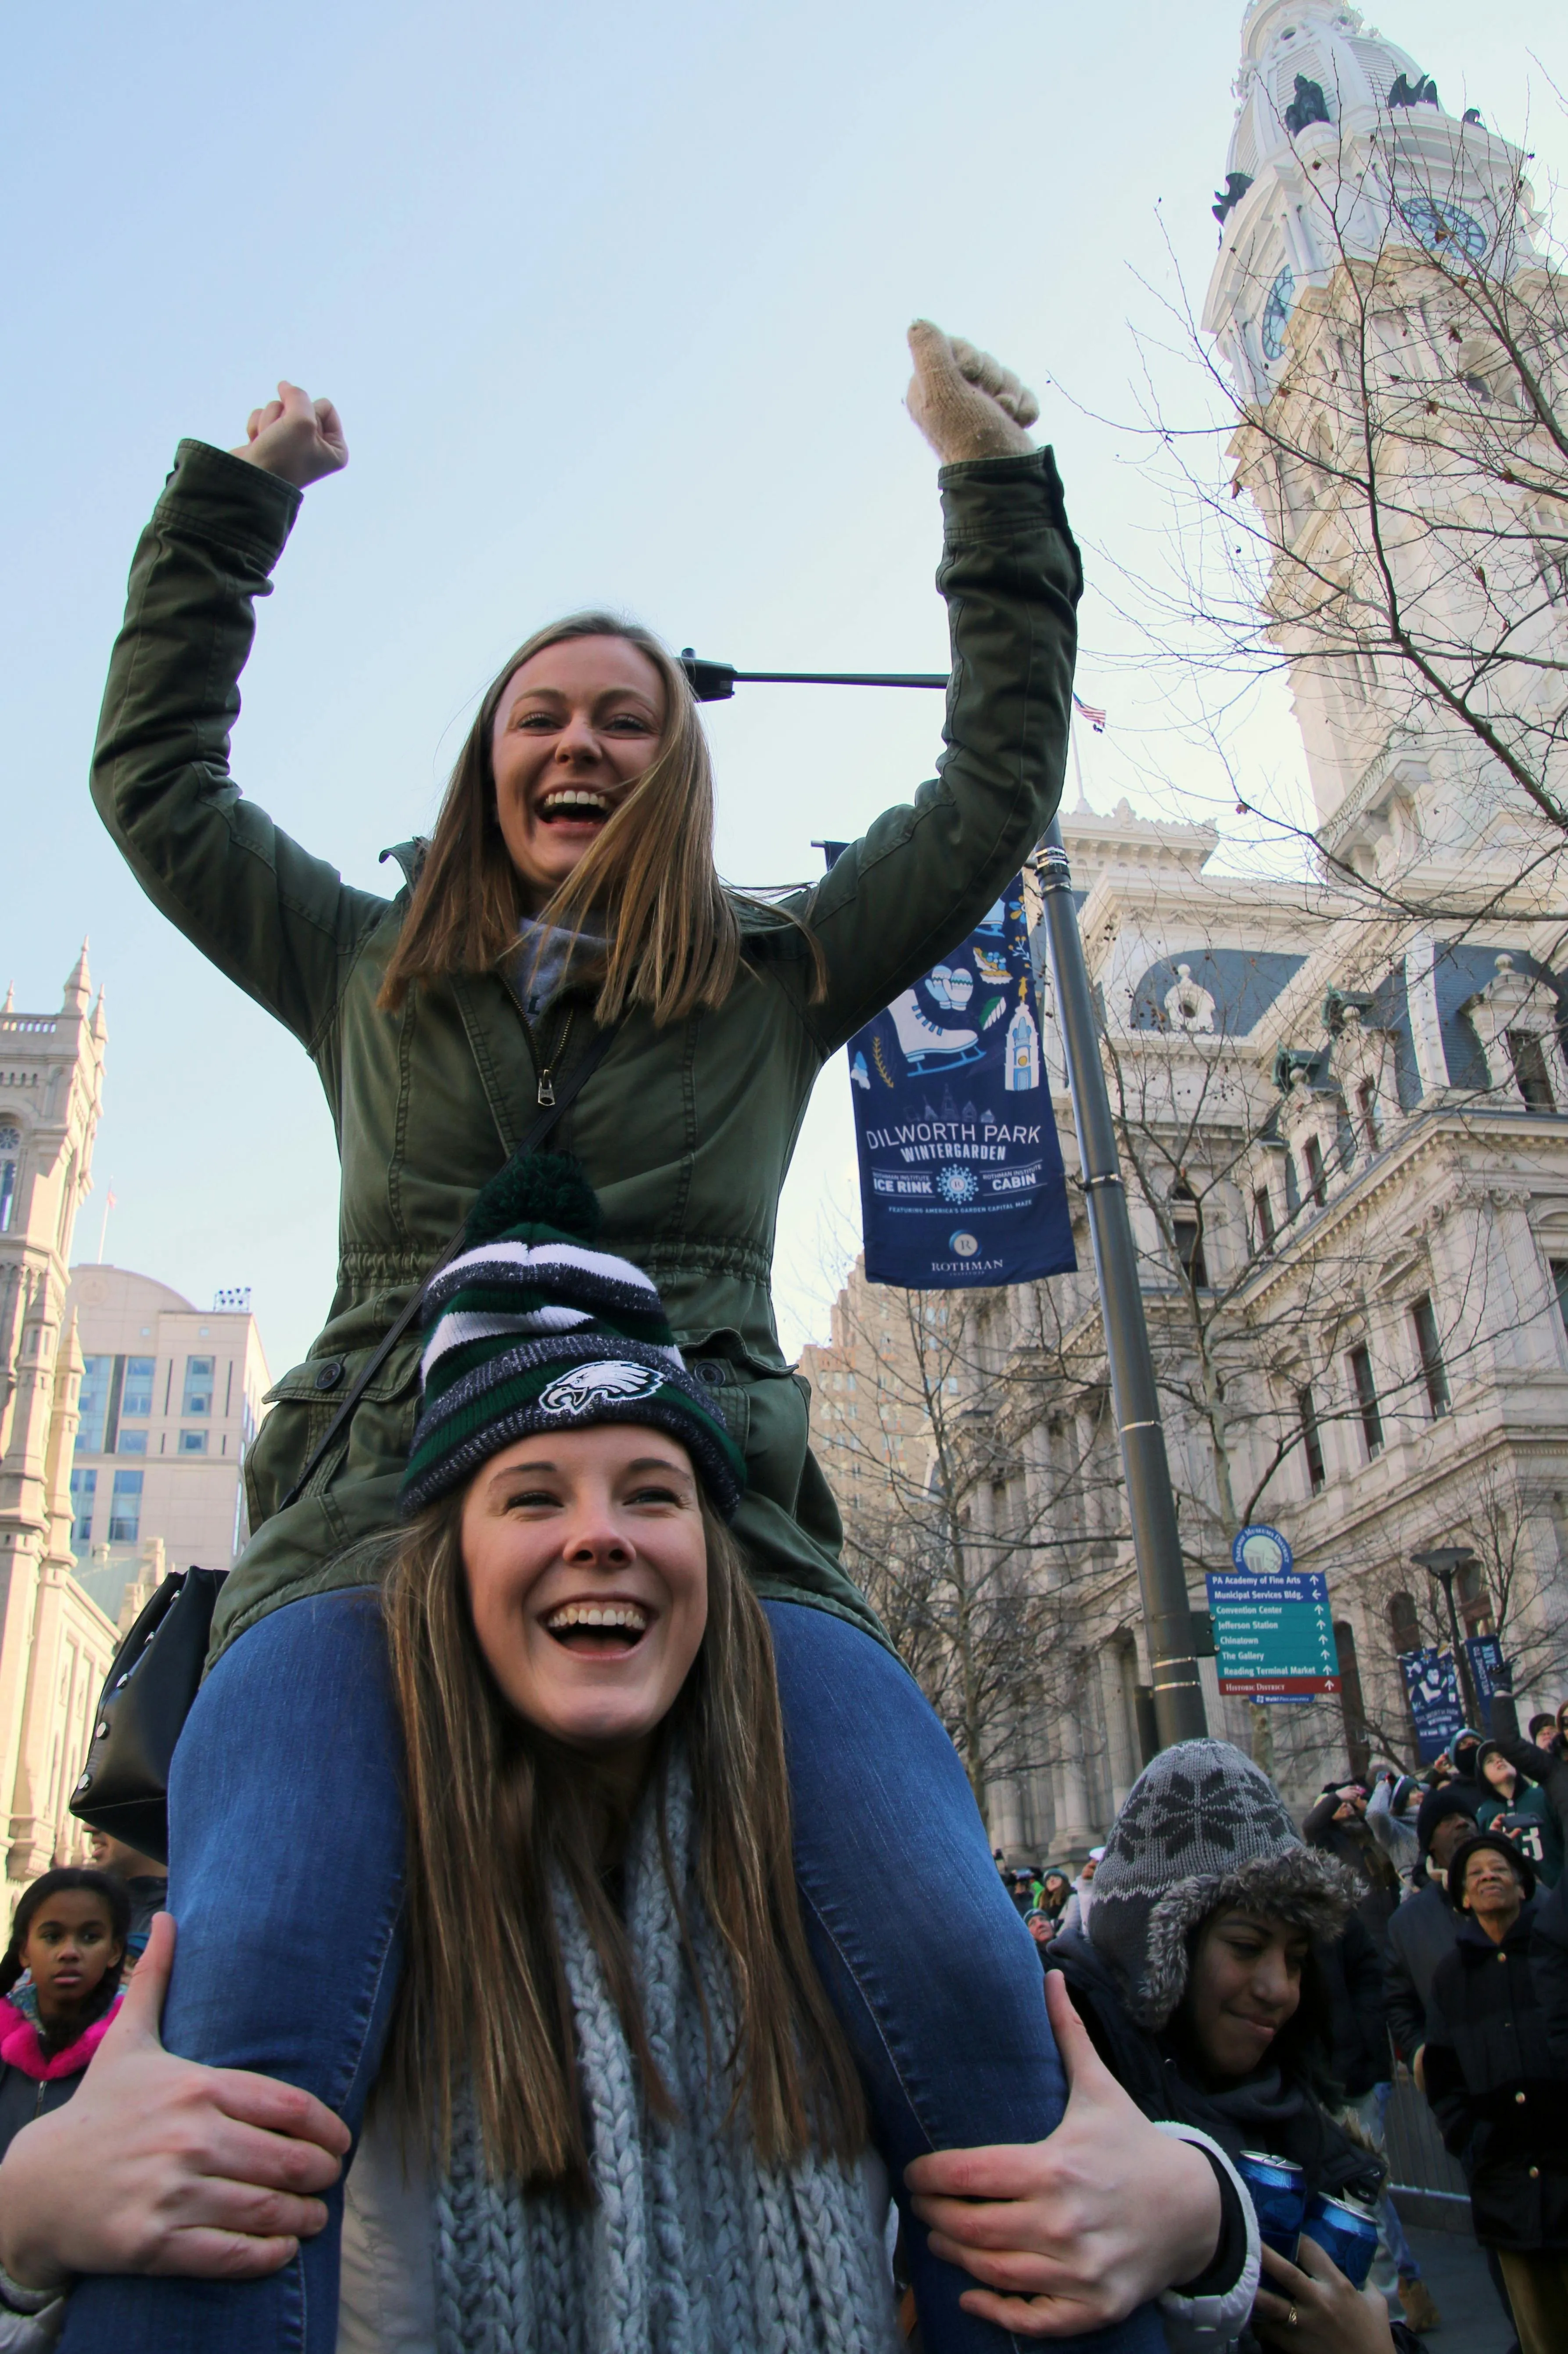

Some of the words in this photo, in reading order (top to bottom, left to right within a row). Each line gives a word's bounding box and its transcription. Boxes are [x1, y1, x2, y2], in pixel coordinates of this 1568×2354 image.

[866, 1122, 976, 1149] DILWORTH
[984, 1124, 1041, 1144] PARK
[900, 1142, 1006, 1163] WINTERGARDEN
[983, 1172, 1012, 1180] ROTHMAN
[1013, 1164, 1042, 1176] INSTITUTE
[874, 1178, 894, 1192] ICE
[897, 1181, 933, 1193] RINK
[992, 1173, 1036, 1191] CABIN
[988, 1204, 1013, 1212] CAPITAL
[931, 1259, 1003, 1272] ROTHMAN
[1225, 1576, 1257, 1586] Academy
[1259, 1576, 1267, 1585] of
[1269, 1576, 1284, 1585] Fine
[1286, 1576, 1301, 1585] Arts
[1214, 1590, 1250, 1600] Municipal
[1252, 1590, 1282, 1599] Services
[1284, 1590, 1303, 1600] Bldg.
[1216, 1605, 1257, 1615] Convention
[1259, 1605, 1282, 1615] Center
[1218, 1621, 1250, 1631] Jefferson
[1252, 1620, 1278, 1629] Station
[1220, 1636, 1259, 1645] Chinatown
[1222, 1652, 1236, 1661] The
[1238, 1651, 1264, 1661] Gallery
[1224, 1667, 1254, 1677] Reading
[1256, 1666, 1288, 1675] Terminal
[1290, 1666, 1316, 1675] Market
